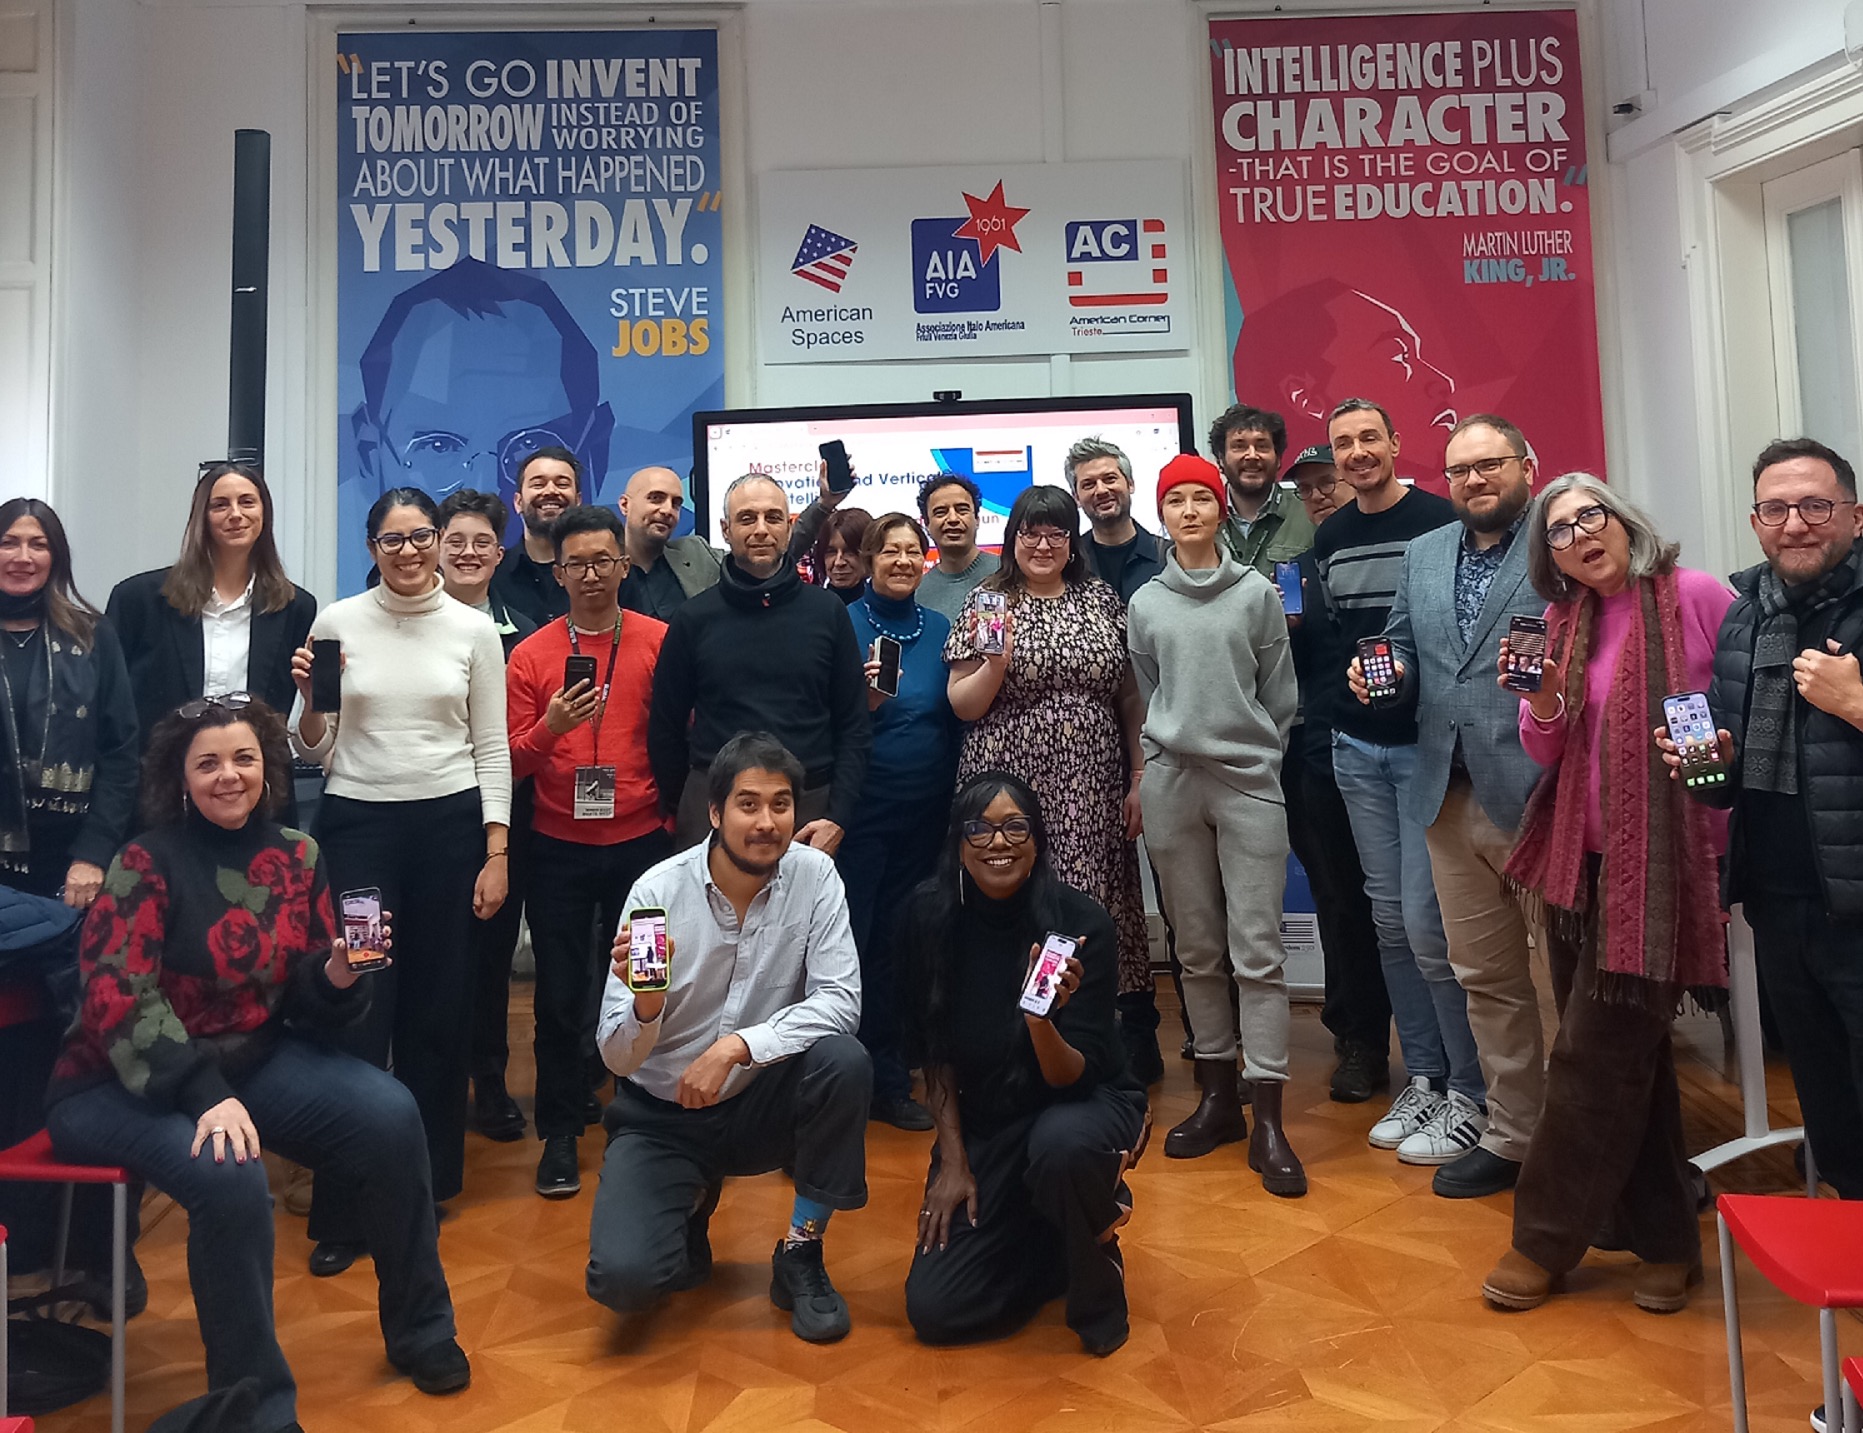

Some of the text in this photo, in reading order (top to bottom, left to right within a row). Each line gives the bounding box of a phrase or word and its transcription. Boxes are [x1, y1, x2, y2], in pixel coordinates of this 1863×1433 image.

[1471, 36, 1564, 88] PLUS
[465, 59, 537, 99] GO
[546, 58, 702, 99] INVENT
[352, 103, 545, 154] TOMORROW
[551, 101, 704, 127] INSTEAD OF
[1221, 91, 1570, 152] CHARACTER
[551, 126, 704, 151] WORRYING
[353, 154, 705, 197] ABOUT WHAT HAPPENED
[1324, 155, 1349, 178] IS
[1359, 153, 1415, 177] THE
[1426, 150, 1511, 175] GOAL
[1525, 148, 1568, 173] OF
[1230, 184, 1328, 224] TRUE
[975, 217, 1006, 236] 1961
[1069, 223, 1131, 259] AC
[1463, 230, 1573, 257] MARTIN LUTHER
[925, 250, 977, 281] AIA
[1464, 257, 1576, 287] KING, JR.
[610, 287, 709, 318] STEVE
[925, 283, 960, 299] FVG
[781, 305, 873, 324] American
[916, 319, 1025, 334] Associazione Italo Americana
[1070, 314, 1170, 325] American Corner
[612, 318, 710, 357] JOBS
[791, 328, 865, 350] Spaces
[749, 461, 818, 474] Mastercl
[856, 474, 873, 486] nd
